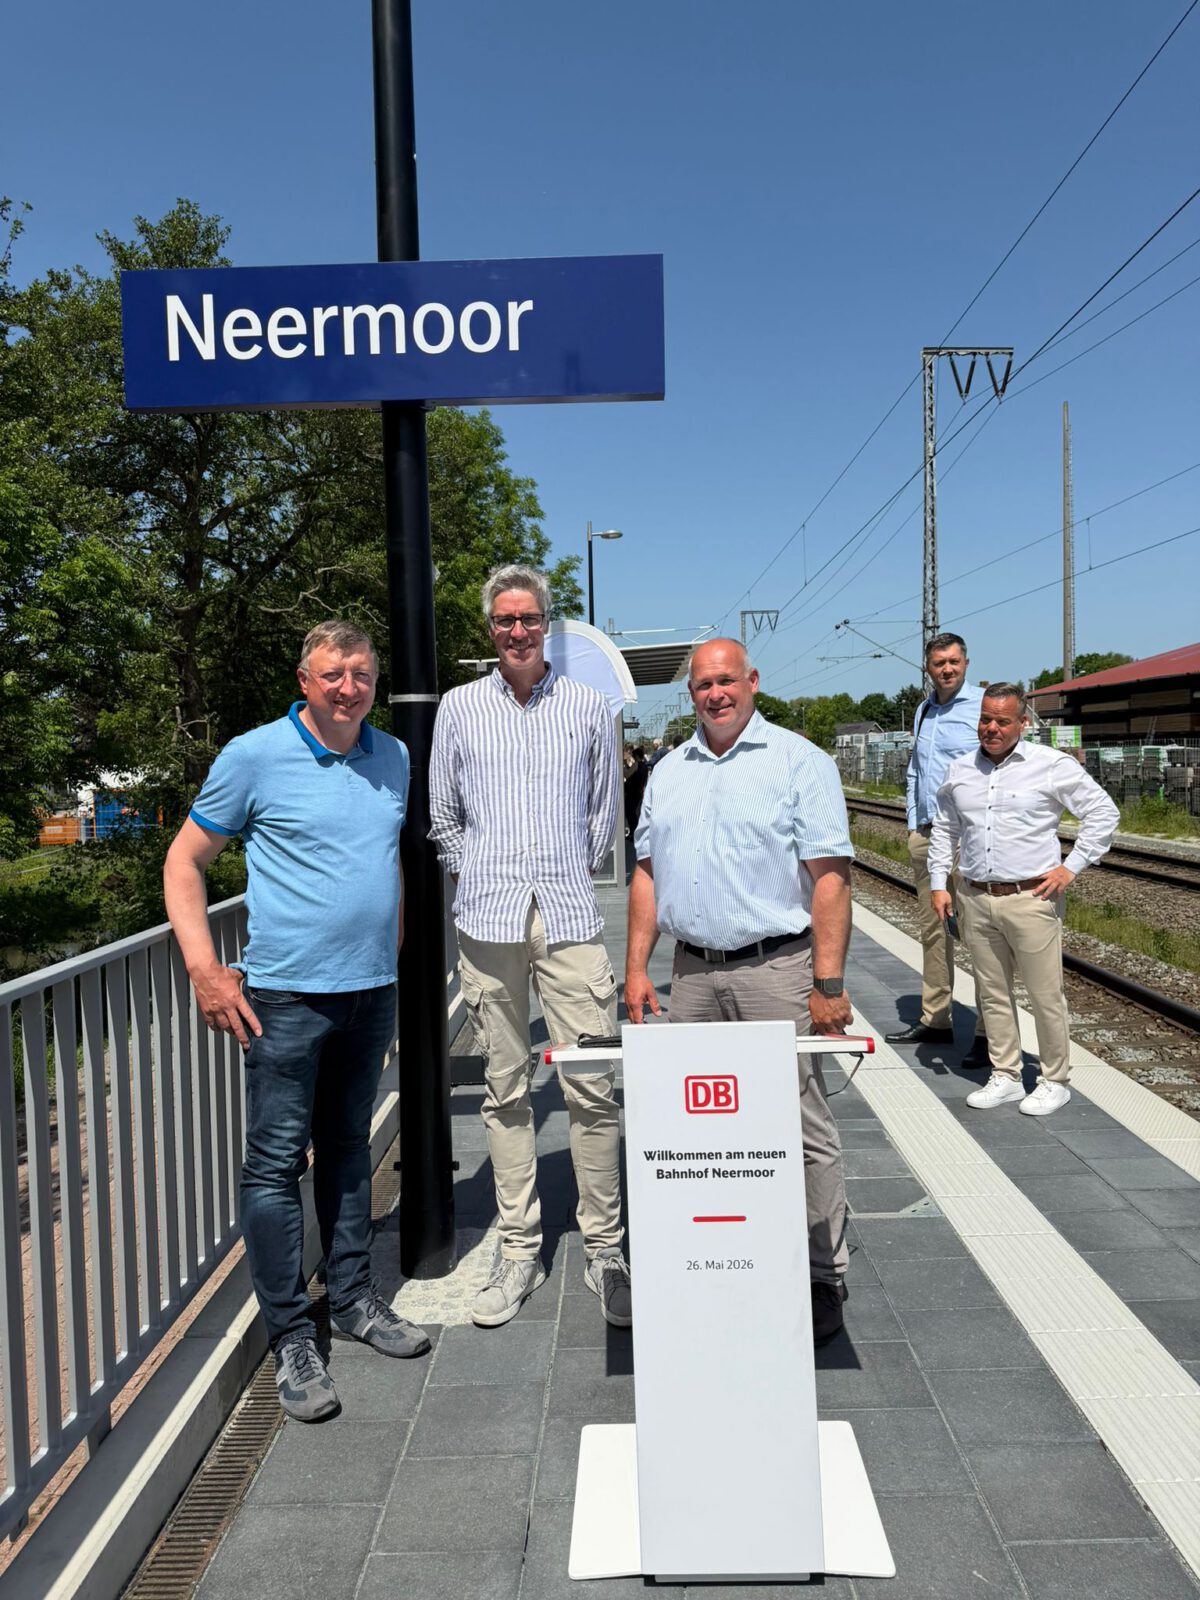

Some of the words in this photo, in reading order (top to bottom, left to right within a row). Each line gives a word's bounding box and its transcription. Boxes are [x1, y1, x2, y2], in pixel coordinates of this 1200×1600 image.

[165, 293, 534, 362] Neermoor
[691, 1081, 733, 1108] DB
[643, 1149, 722, 1162] Willkommen
[725, 1151, 745, 1161] am
[747, 1150, 787, 1160] neuen
[656, 1167, 709, 1180] Bahnhof
[711, 1167, 776, 1179] Neermoor
[686, 1260, 703, 1271] 26.
[705, 1260, 725, 1270] Mai
[726, 1259, 754, 1270] 2026
